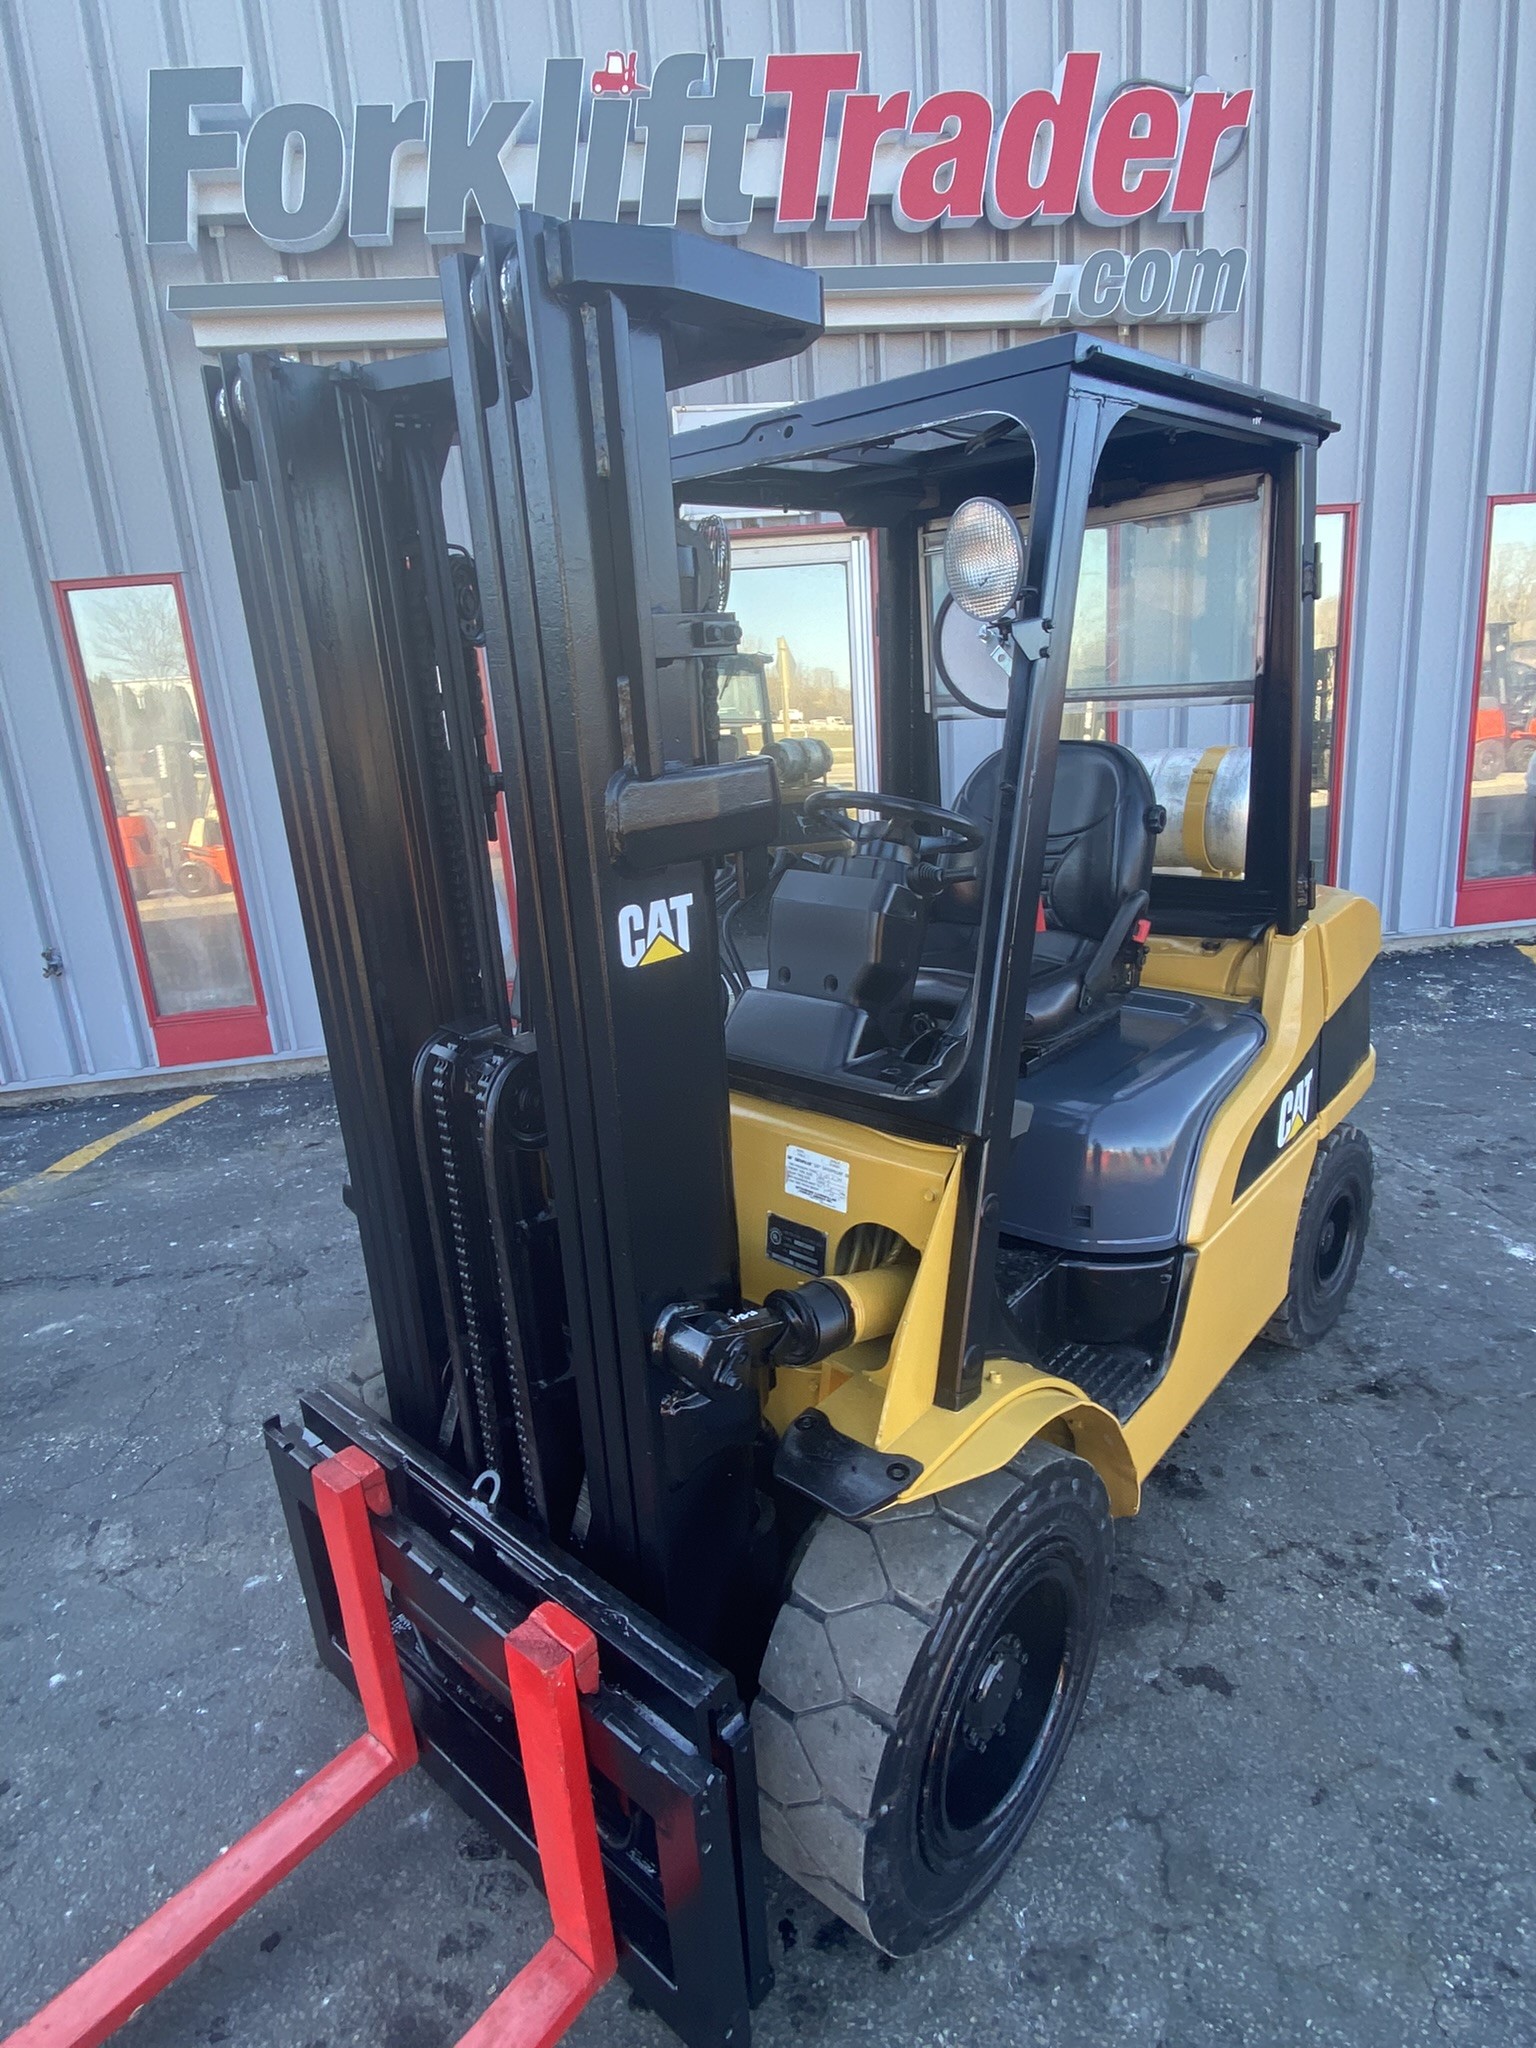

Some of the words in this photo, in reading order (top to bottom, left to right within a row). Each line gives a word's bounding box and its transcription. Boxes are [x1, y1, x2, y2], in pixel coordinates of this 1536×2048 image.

[1050, 247, 1249, 319] .com
[617, 892, 694, 968] CAT
[1277, 1068, 1314, 1149] CAT
